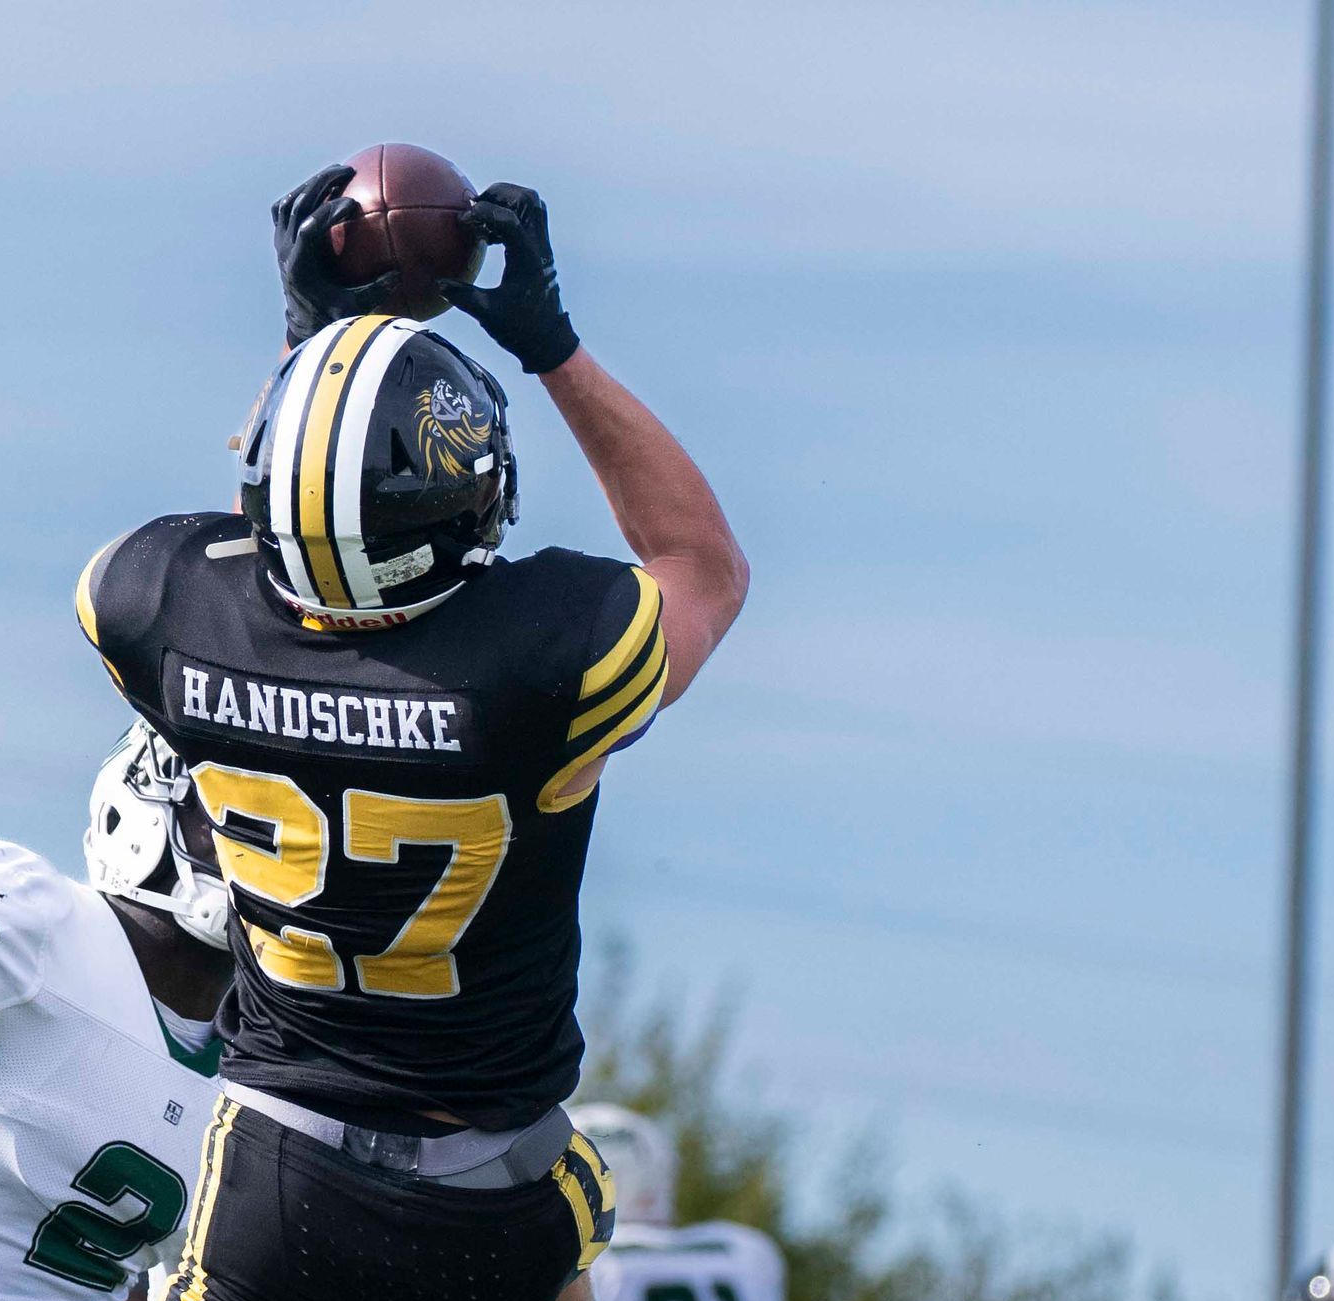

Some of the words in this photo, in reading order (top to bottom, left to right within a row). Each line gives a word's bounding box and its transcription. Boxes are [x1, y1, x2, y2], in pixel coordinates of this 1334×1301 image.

[181, 665, 462, 752] HANDSCHKE
[189, 761, 513, 1000] 27
[23, 1140, 188, 1293] 2
